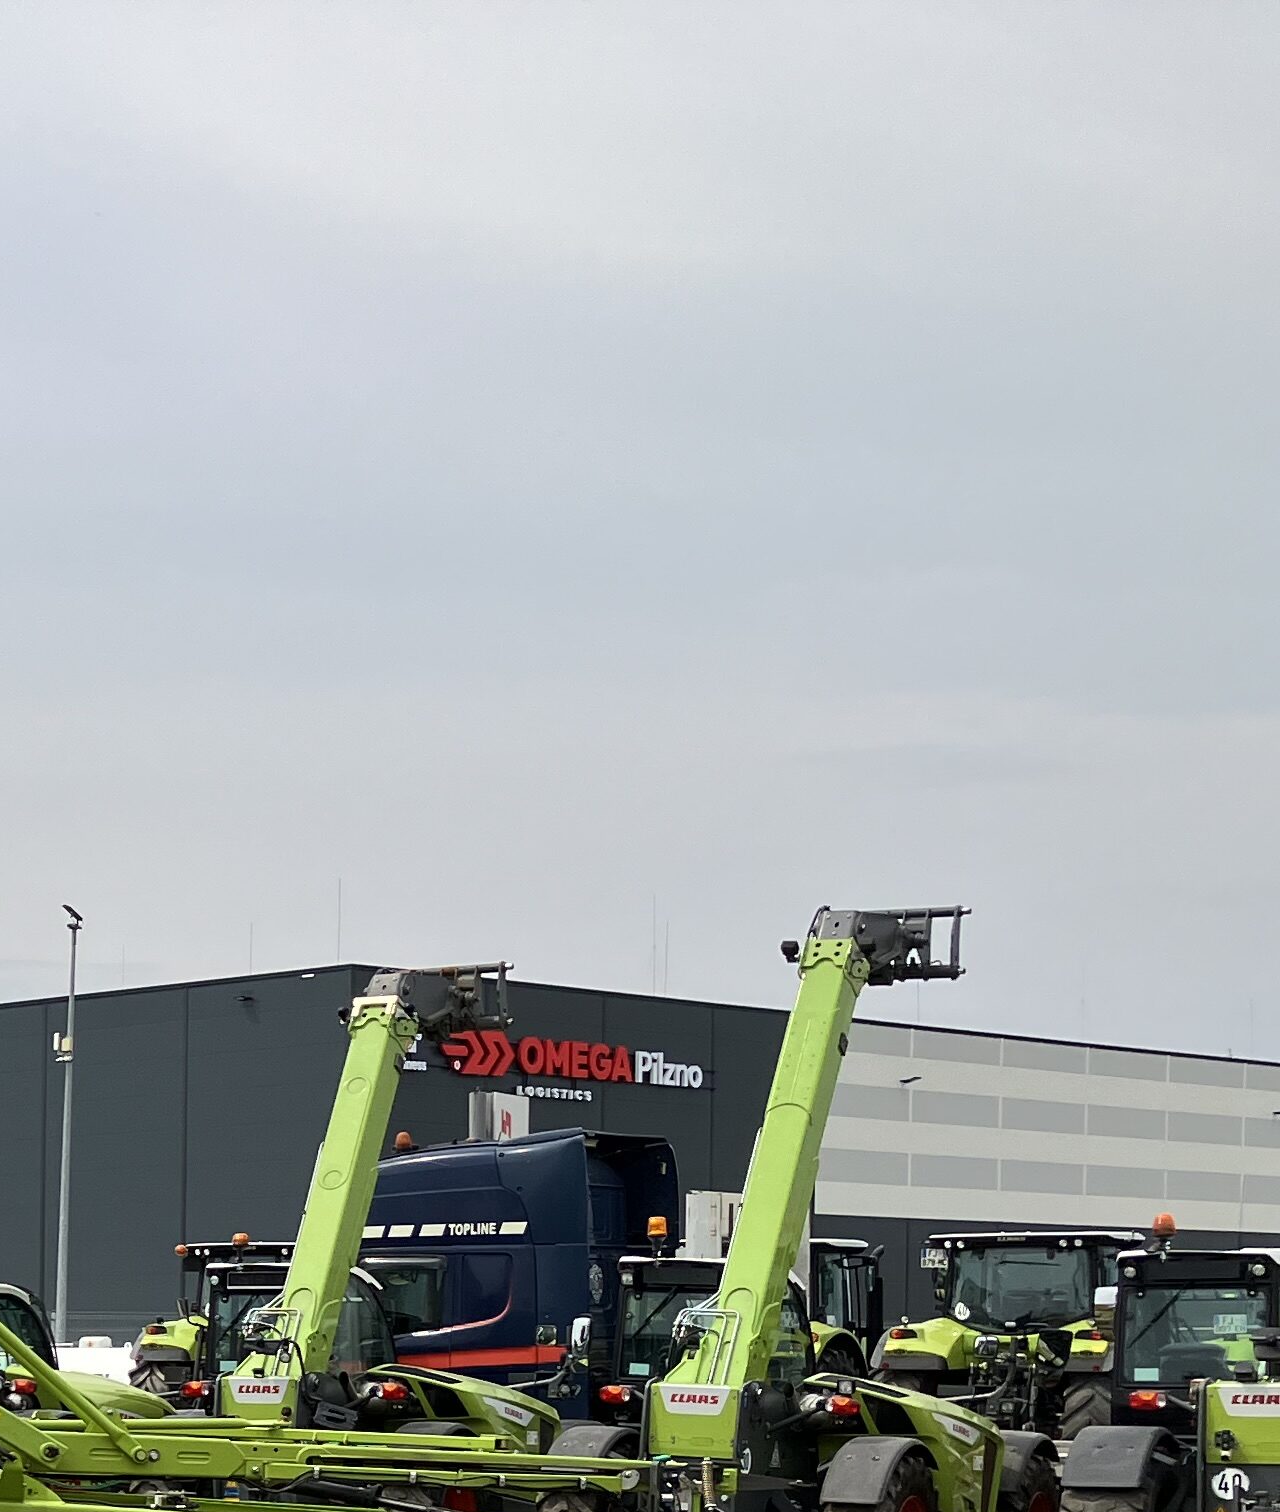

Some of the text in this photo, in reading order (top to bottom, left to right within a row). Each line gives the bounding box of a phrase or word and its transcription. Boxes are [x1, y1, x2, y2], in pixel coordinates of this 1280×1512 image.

[518, 1036, 704, 1089] OMEGA Pilzno
[516, 1085, 593, 1102] LOGISTICS
[448, 1222, 497, 1236] TOPLINE
[238, 1385, 280, 1394] CLAAS
[670, 1393, 719, 1405] CLAAS
[1218, 1473, 1242, 1494] 40
